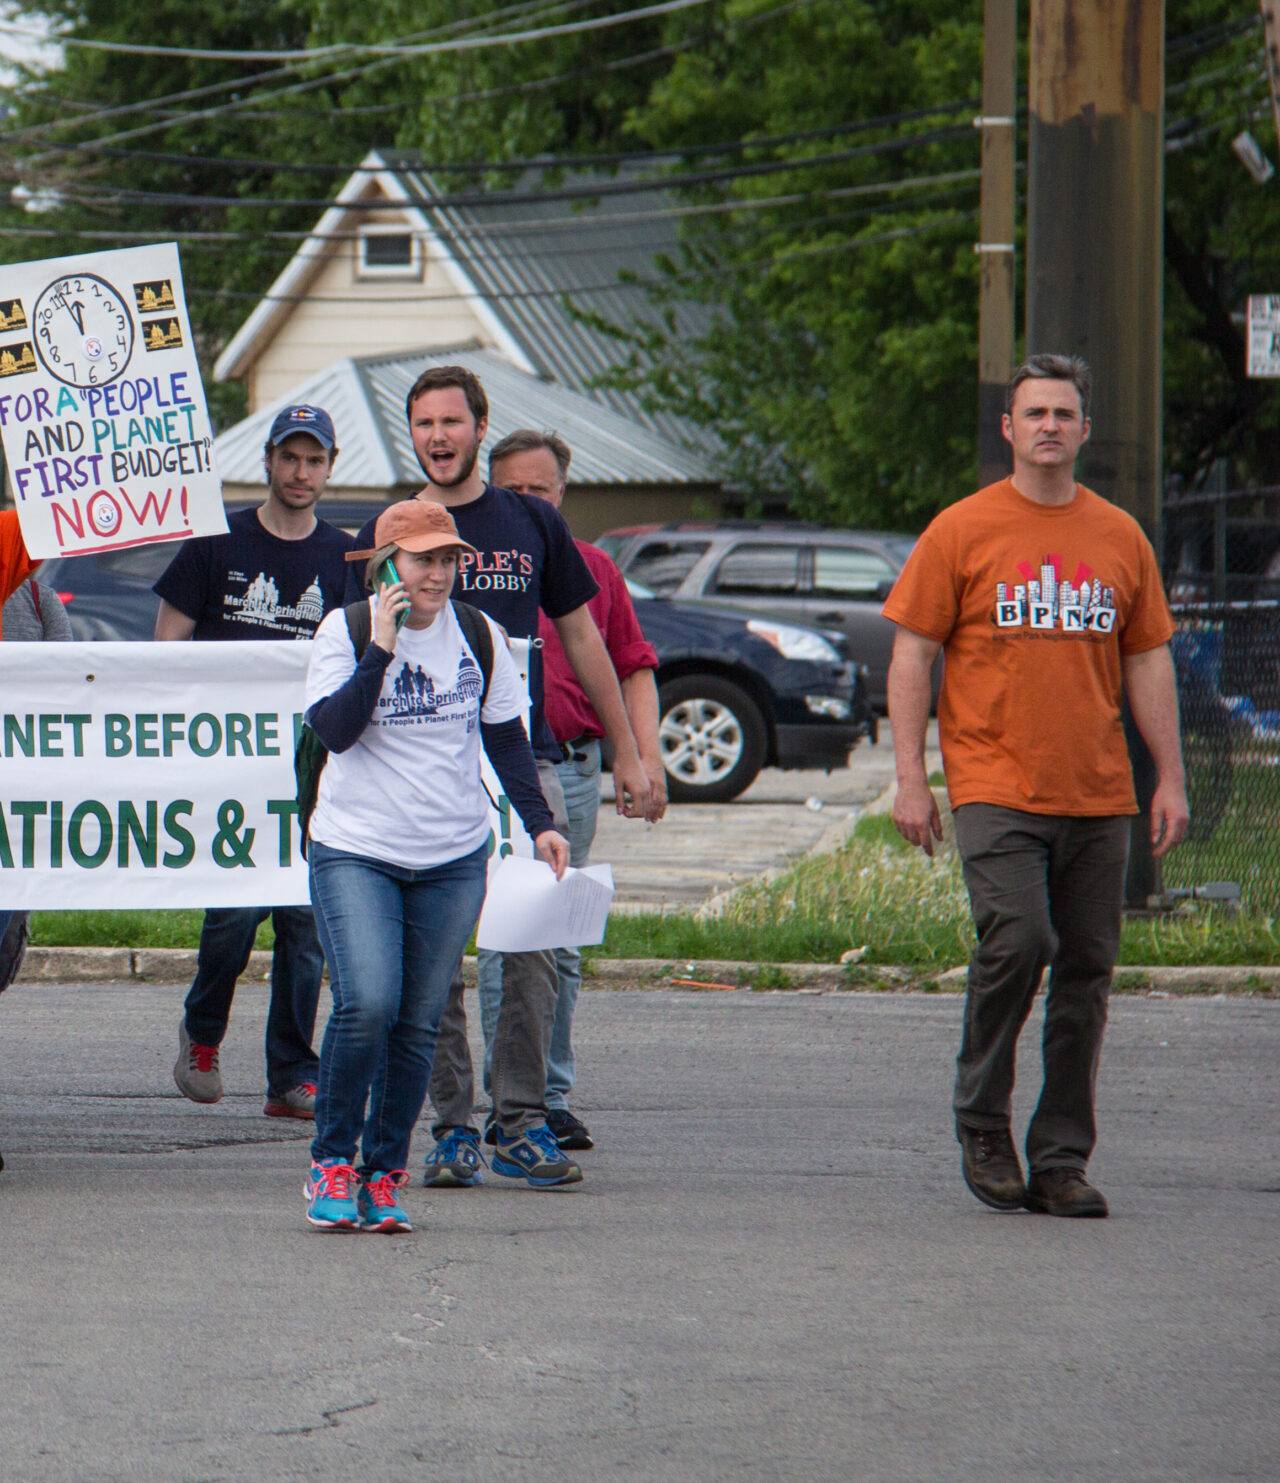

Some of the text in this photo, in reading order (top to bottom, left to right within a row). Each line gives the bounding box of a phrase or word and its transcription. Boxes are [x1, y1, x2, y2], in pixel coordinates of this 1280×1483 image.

[104, 301, 116, 313] 2
[39, 308, 53, 325] 10
[116, 315, 125, 330] 3
[40, 326, 51, 344] 9
[116, 334, 127, 352] 4
[50, 347, 61, 363] 8
[108, 352, 119, 372] 5
[64, 364, 77, 382] 7
[88, 366, 98, 384] 6
[55, 387, 78, 416] A
[25, 404, 197, 461] AND PLANET
[15, 454, 103, 500] FIRST
[51, 486, 189, 546] NOW!
[459, 549, 533, 575] PLE'S
[461, 573, 532, 593] LOBBY
[224, 594, 255, 608] March
[412, 695, 423, 706] to
[389, 718, 415, 728] People
[425, 714, 449, 724] Planet
[451, 711, 467, 721] First
[106, 712, 281, 757] BEFORE
[212, 799, 257, 869] &
